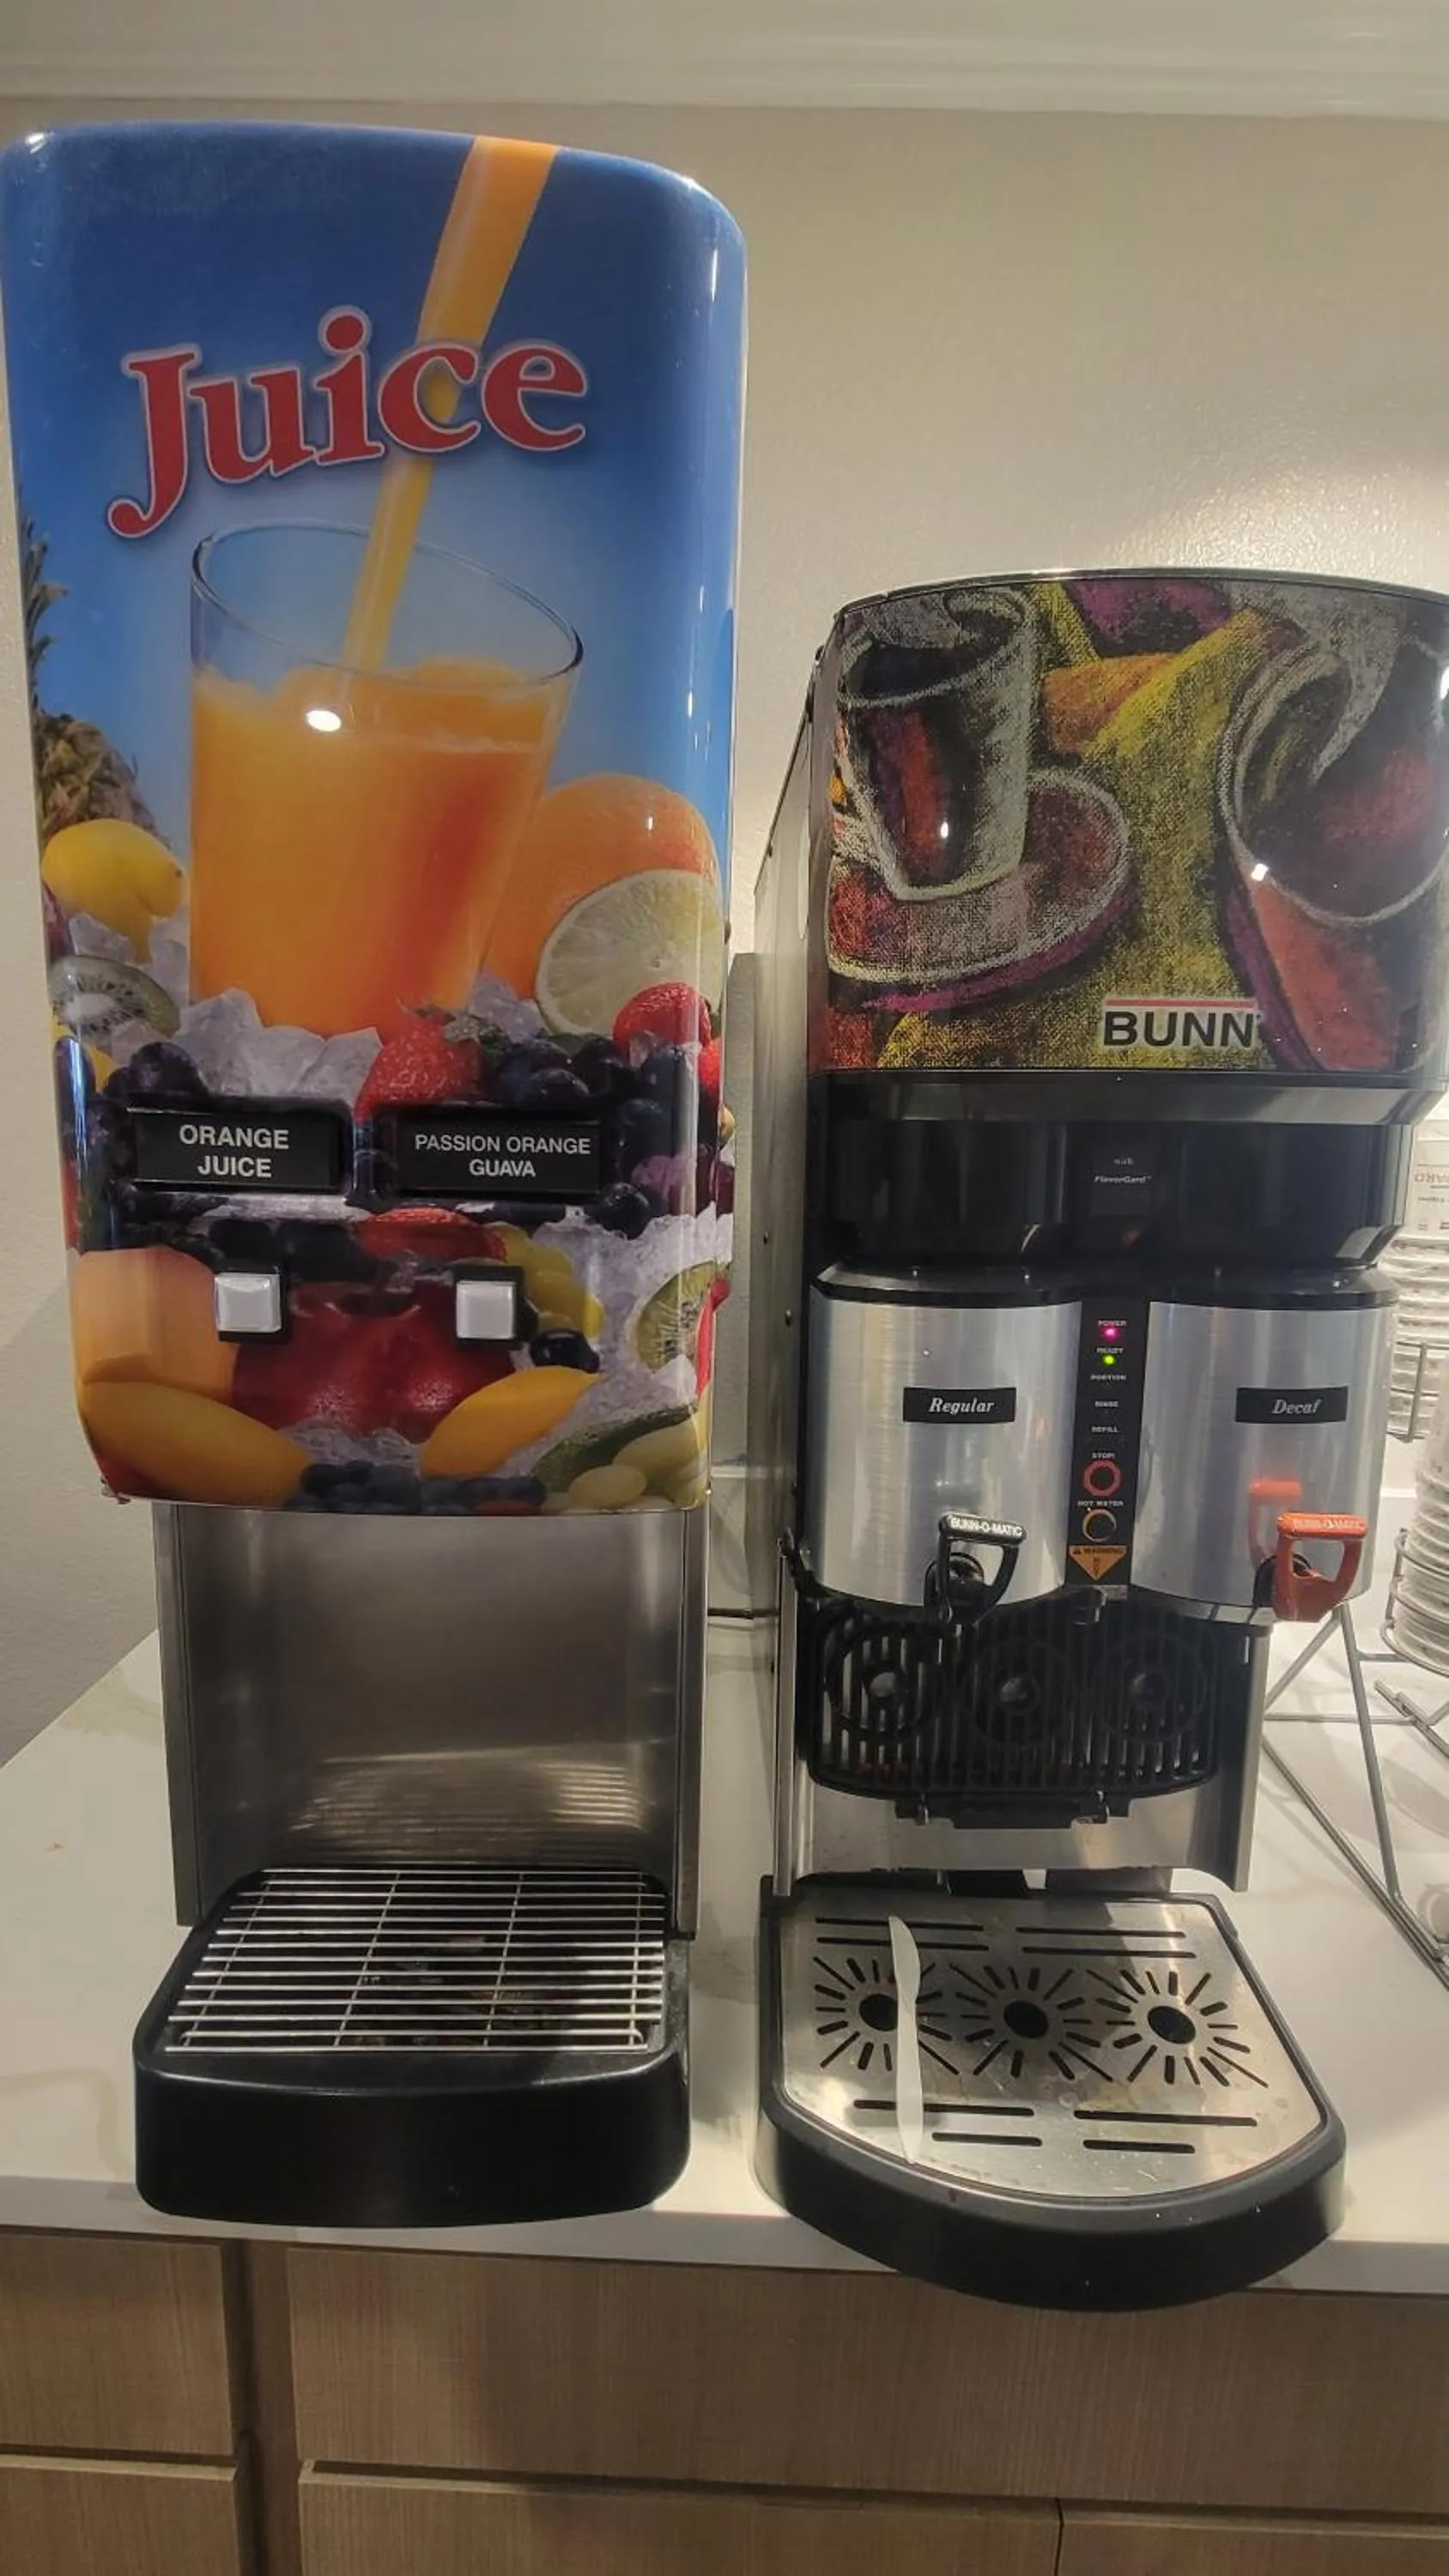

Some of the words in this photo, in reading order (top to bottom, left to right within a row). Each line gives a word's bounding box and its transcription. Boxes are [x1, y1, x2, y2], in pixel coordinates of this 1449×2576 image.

[107, 308, 587, 538] Juice
[1103, 1011, 1254, 1047] BUNN
[179, 1123, 289, 1150] ORANGE
[415, 1134, 501, 1152] PASSION
[506, 1135, 591, 1155] ORANGE
[197, 1155, 272, 1177] JUICE
[469, 1159, 536, 1177] GUAVA
[928, 1397, 995, 1415] Regular
[1271, 1398, 1323, 1414] Decaf
